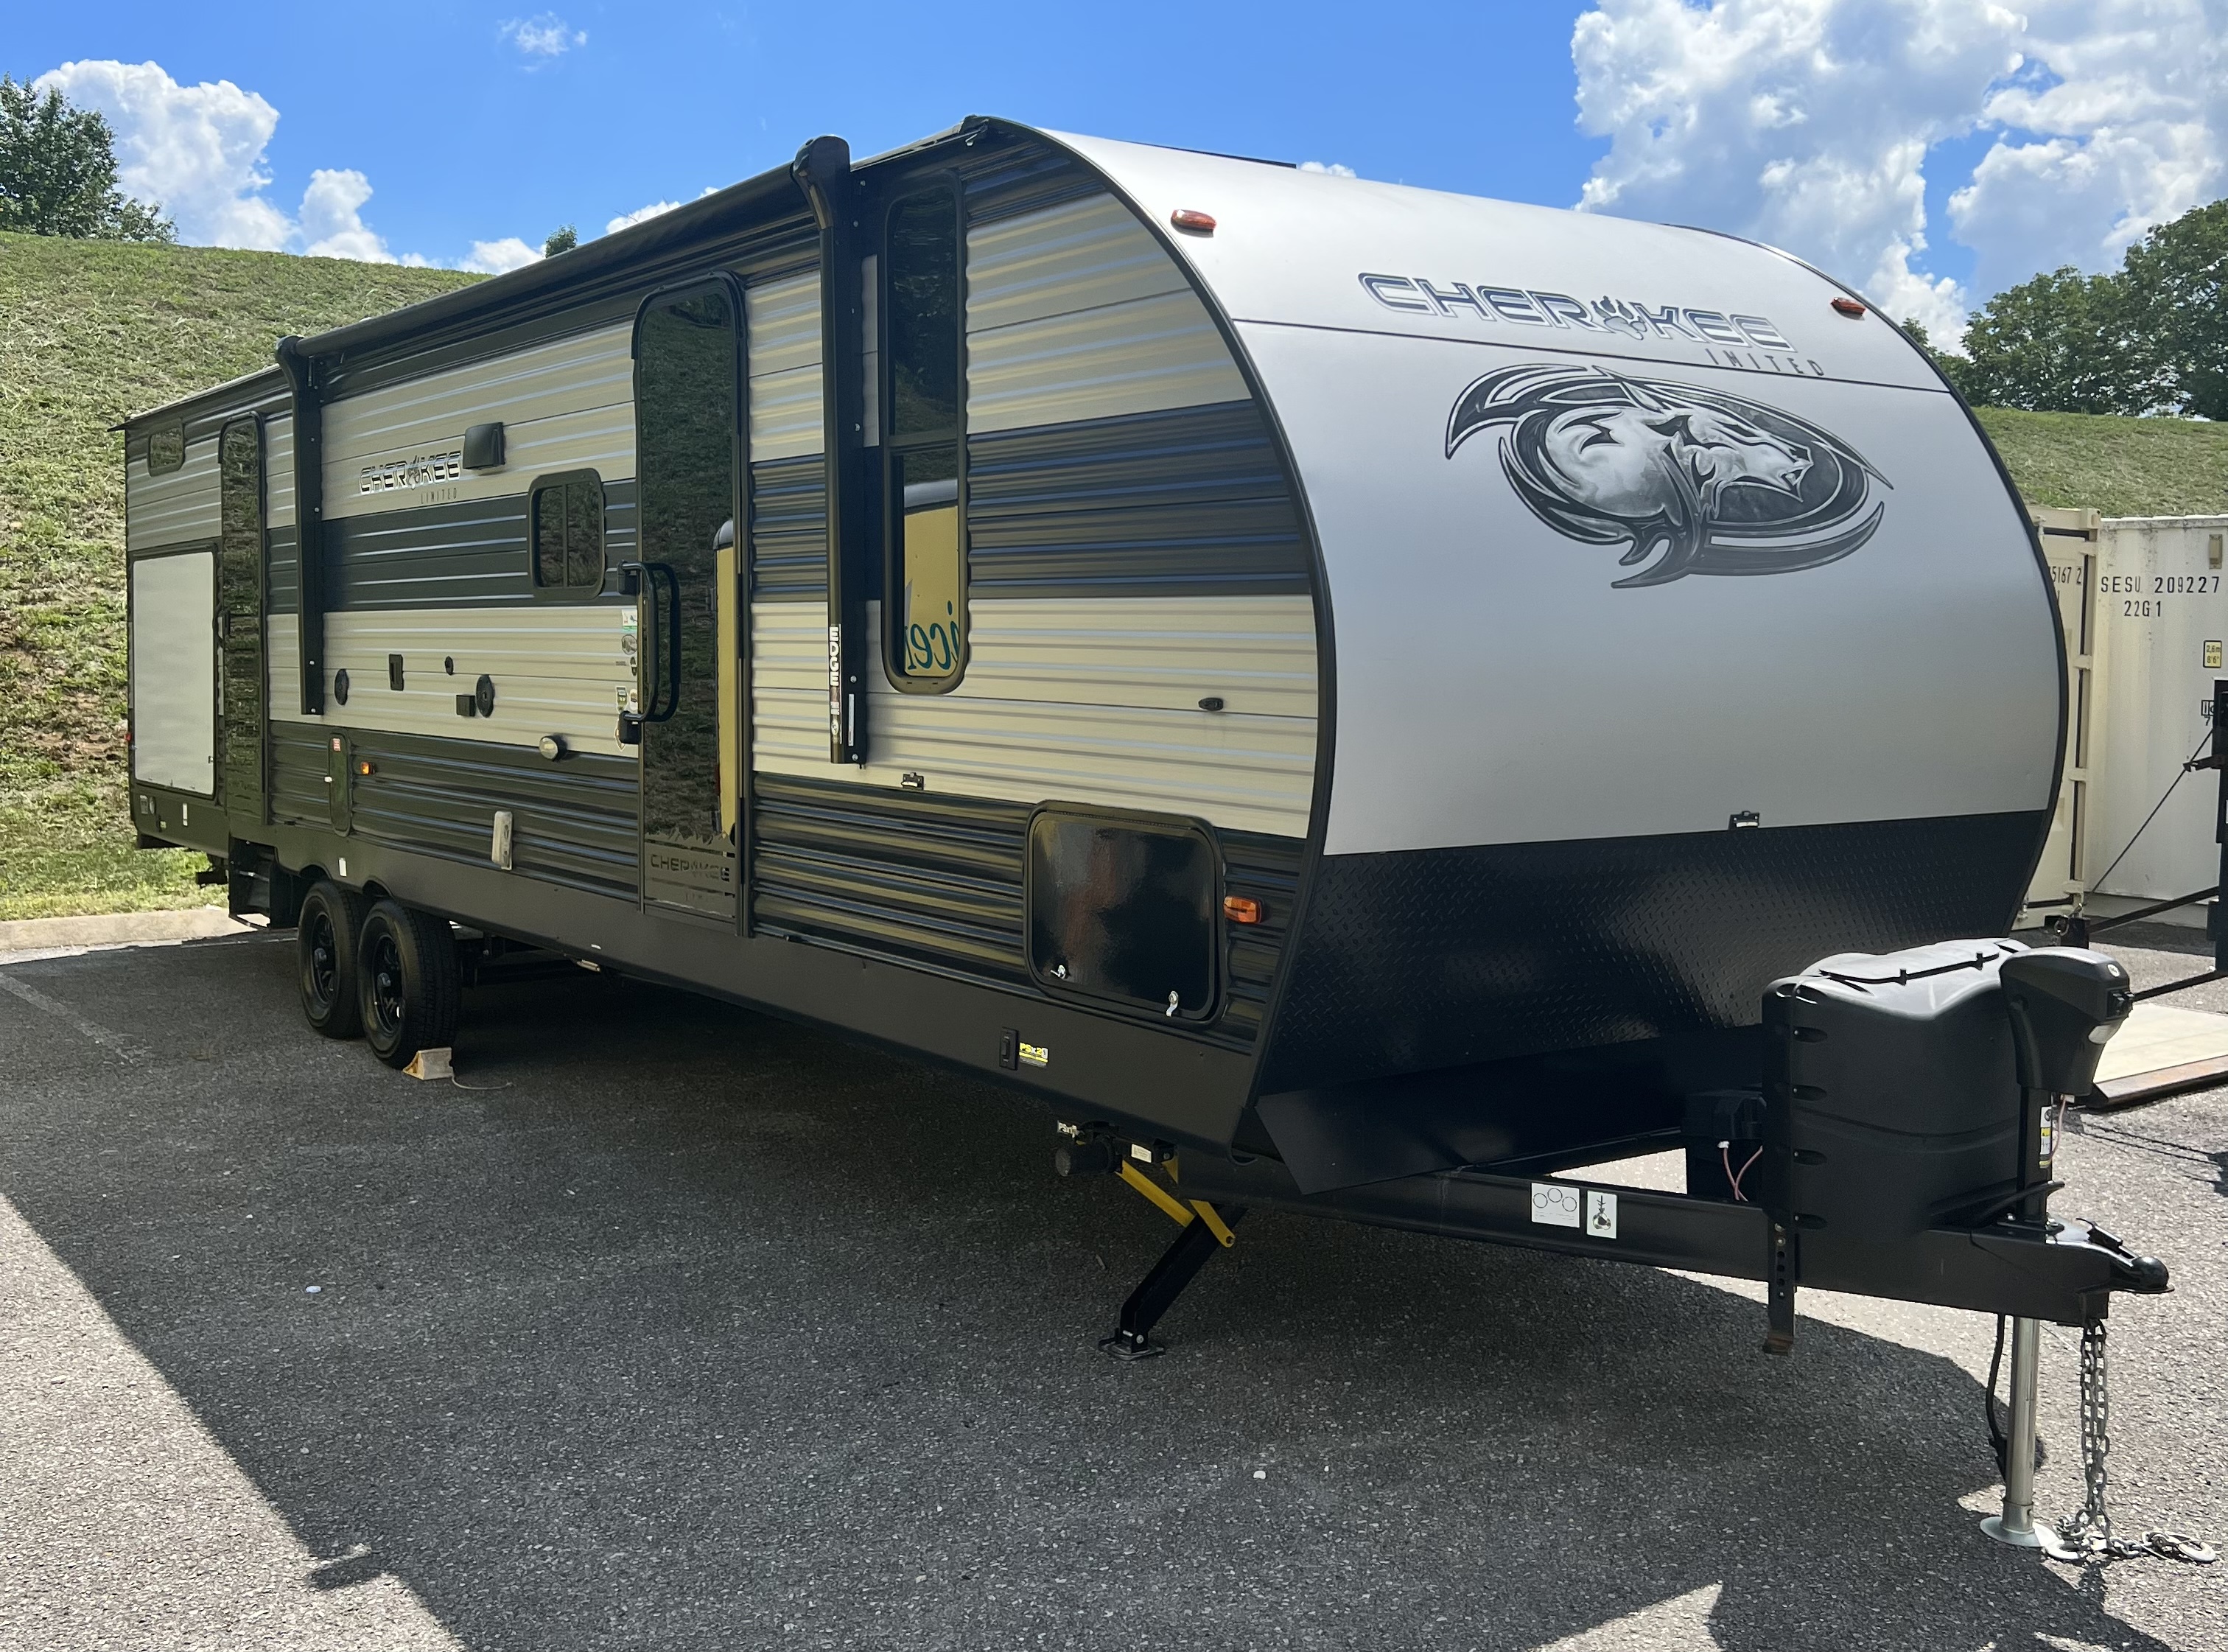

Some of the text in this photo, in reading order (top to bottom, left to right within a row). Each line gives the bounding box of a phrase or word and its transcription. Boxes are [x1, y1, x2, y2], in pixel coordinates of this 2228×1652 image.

[2101, 576, 2220, 594] SESU 209227
[829, 626, 839, 686] EDGE
